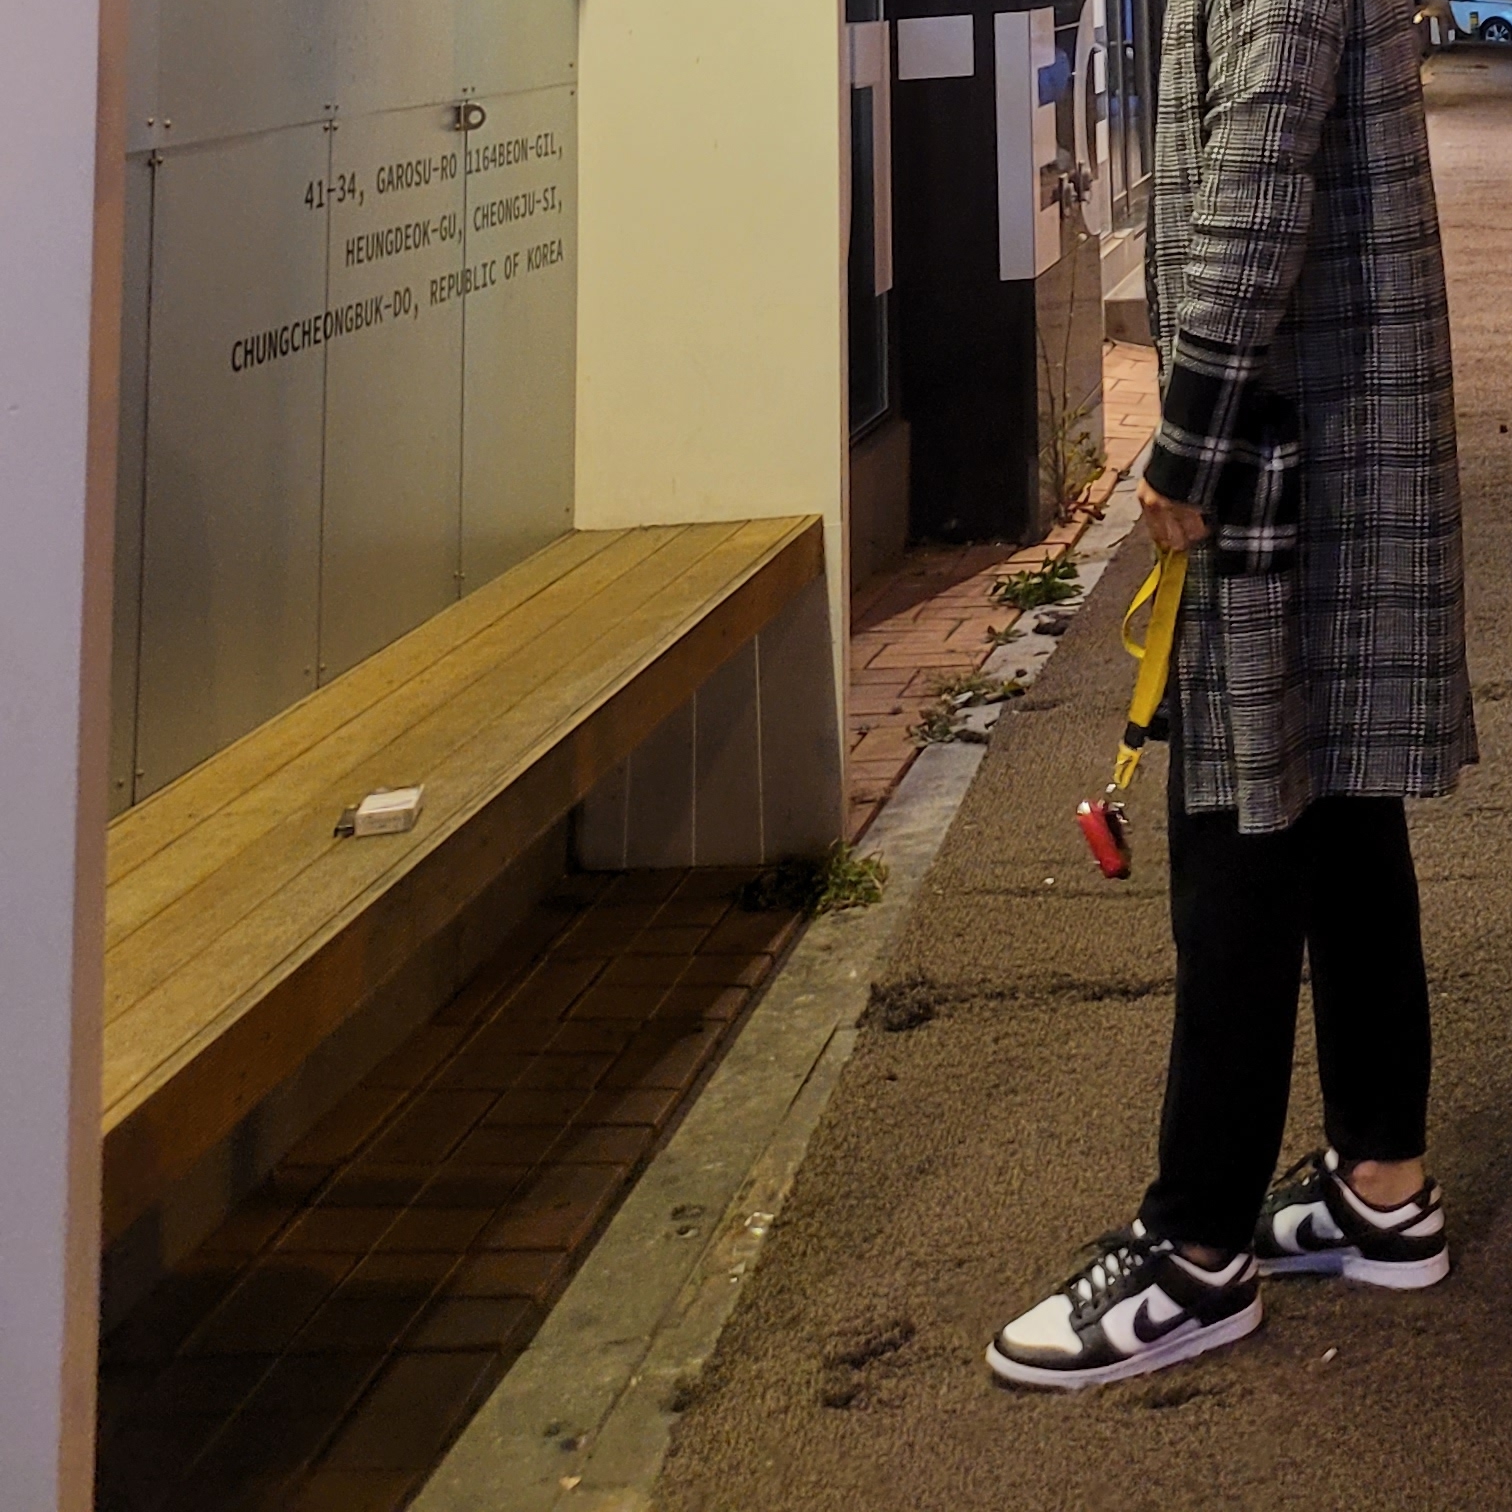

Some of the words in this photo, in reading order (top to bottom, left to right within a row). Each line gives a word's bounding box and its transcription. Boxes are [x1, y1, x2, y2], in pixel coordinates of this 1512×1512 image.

[304, 173, 364, 210] 41-34,
[376, 153, 457, 195] GAROSU-RO
[466, 132, 563, 175] 1164BEON-GIL,
[345, 214, 463, 268] HEUNGDEOK-GU,
[473, 186, 563, 232] CHEONGJU-SI,
[231, 287, 419, 372] CHUNGCHEONGBUK-DO,
[430, 259, 497, 306] REPUBLIC
[504, 251, 520, 280] OF
[527, 239, 564, 273] KOREA
